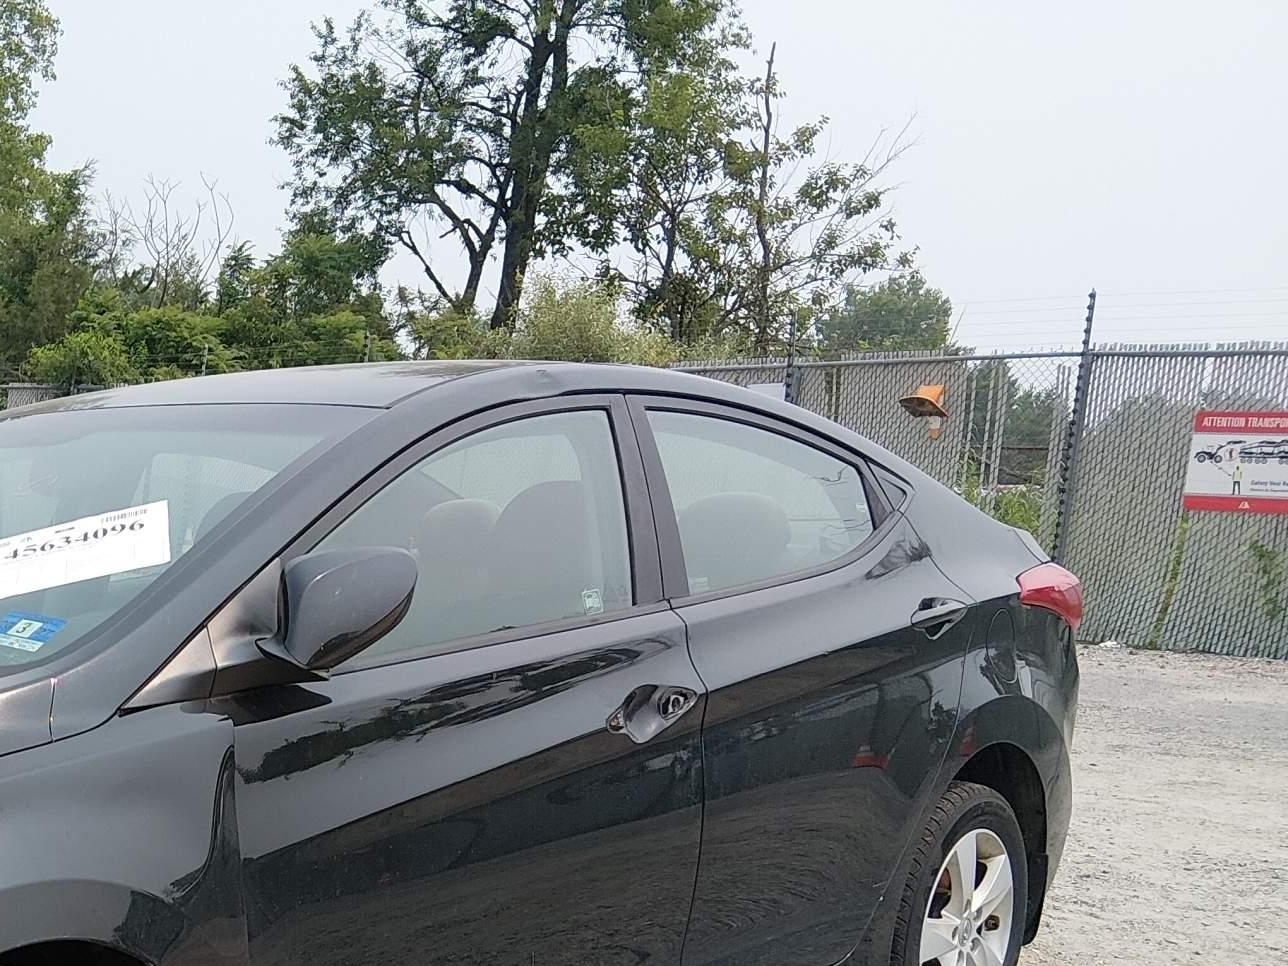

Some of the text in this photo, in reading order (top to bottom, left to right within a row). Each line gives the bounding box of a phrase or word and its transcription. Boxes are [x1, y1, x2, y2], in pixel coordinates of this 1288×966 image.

[1202, 416, 1246, 427] ATTENTION
[4, 520, 145, 559] 45634096
[15, 622, 35, 634] 3
